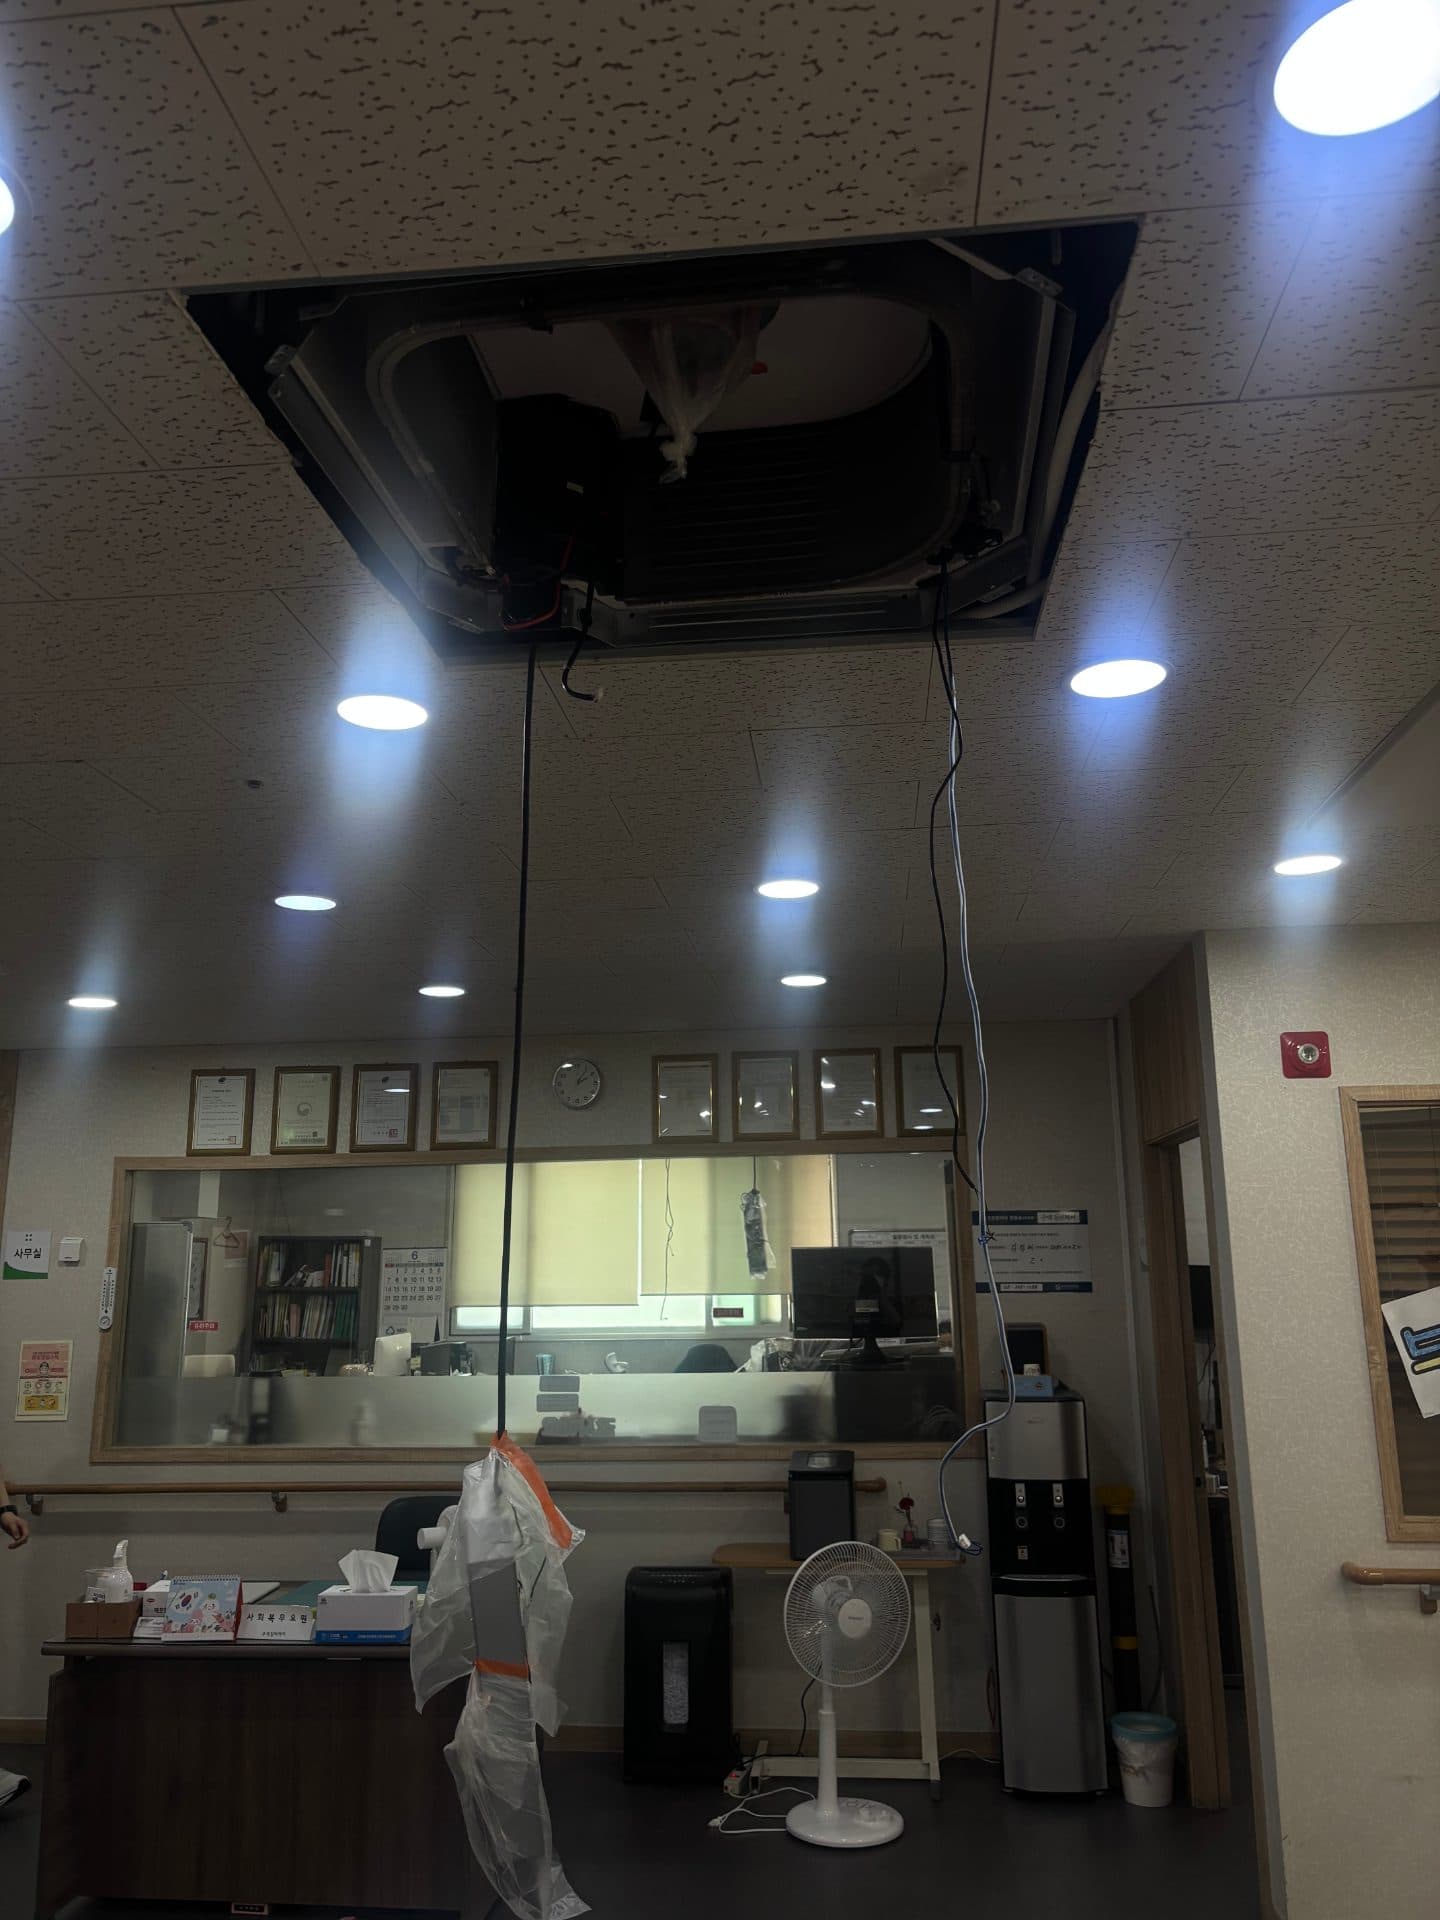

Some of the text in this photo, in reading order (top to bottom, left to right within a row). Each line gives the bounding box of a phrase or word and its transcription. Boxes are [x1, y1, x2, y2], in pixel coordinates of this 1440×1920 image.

[14, 1248, 42, 1259] 사무실
[411, 1251, 418, 1260] 6
[246, 1612, 308, 1624] 사회복무요원
